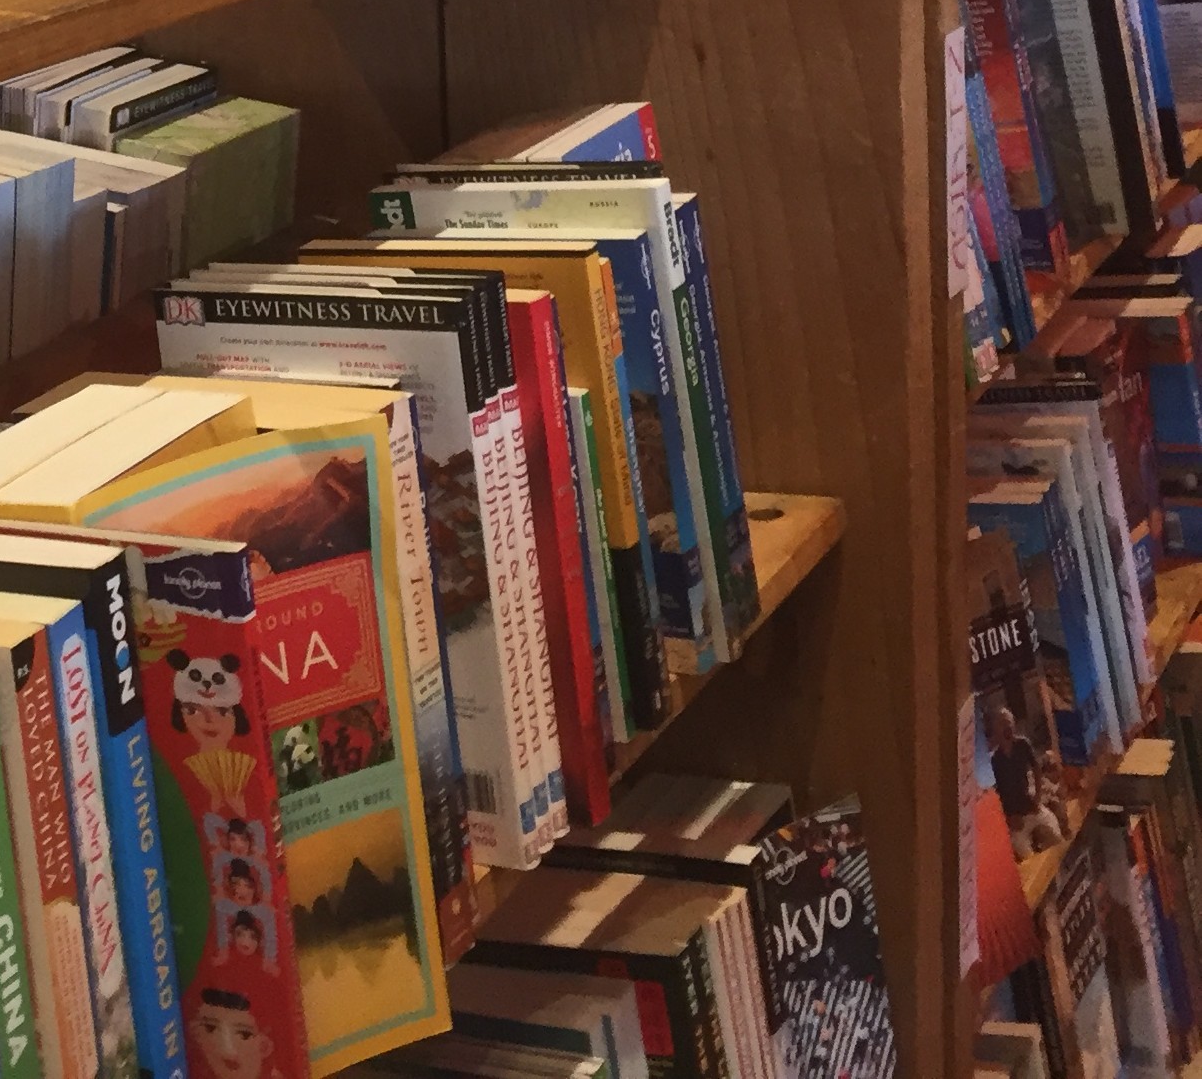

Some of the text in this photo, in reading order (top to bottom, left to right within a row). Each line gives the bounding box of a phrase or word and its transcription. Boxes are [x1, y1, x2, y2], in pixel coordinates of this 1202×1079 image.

[166, 297, 446, 325] DK EYEWITNESS TRAVEL
[663, 201, 680, 268] Bradt
[650, 308, 670, 396] Cyprus
[680, 297, 698, 387] Georgia
[106, 573, 136, 706] MOON
[397, 473, 416, 558] River
[410, 572, 429, 653] Town
[482, 450, 529, 771] BEIJING & SHANGHAI
[494, 436, 541, 753] BEIJING & SHANGHAI
[511, 428, 559, 740] BEIJING & SHANGHAI
[968, 618, 1022, 664] STONE
[23, 688, 55, 891] LOVED CHINA
[35, 669, 71, 884] THE MAN WHO
[127, 734, 180, 1060] LIVING ABROAD IN
[773, 887, 853, 962] kyo
